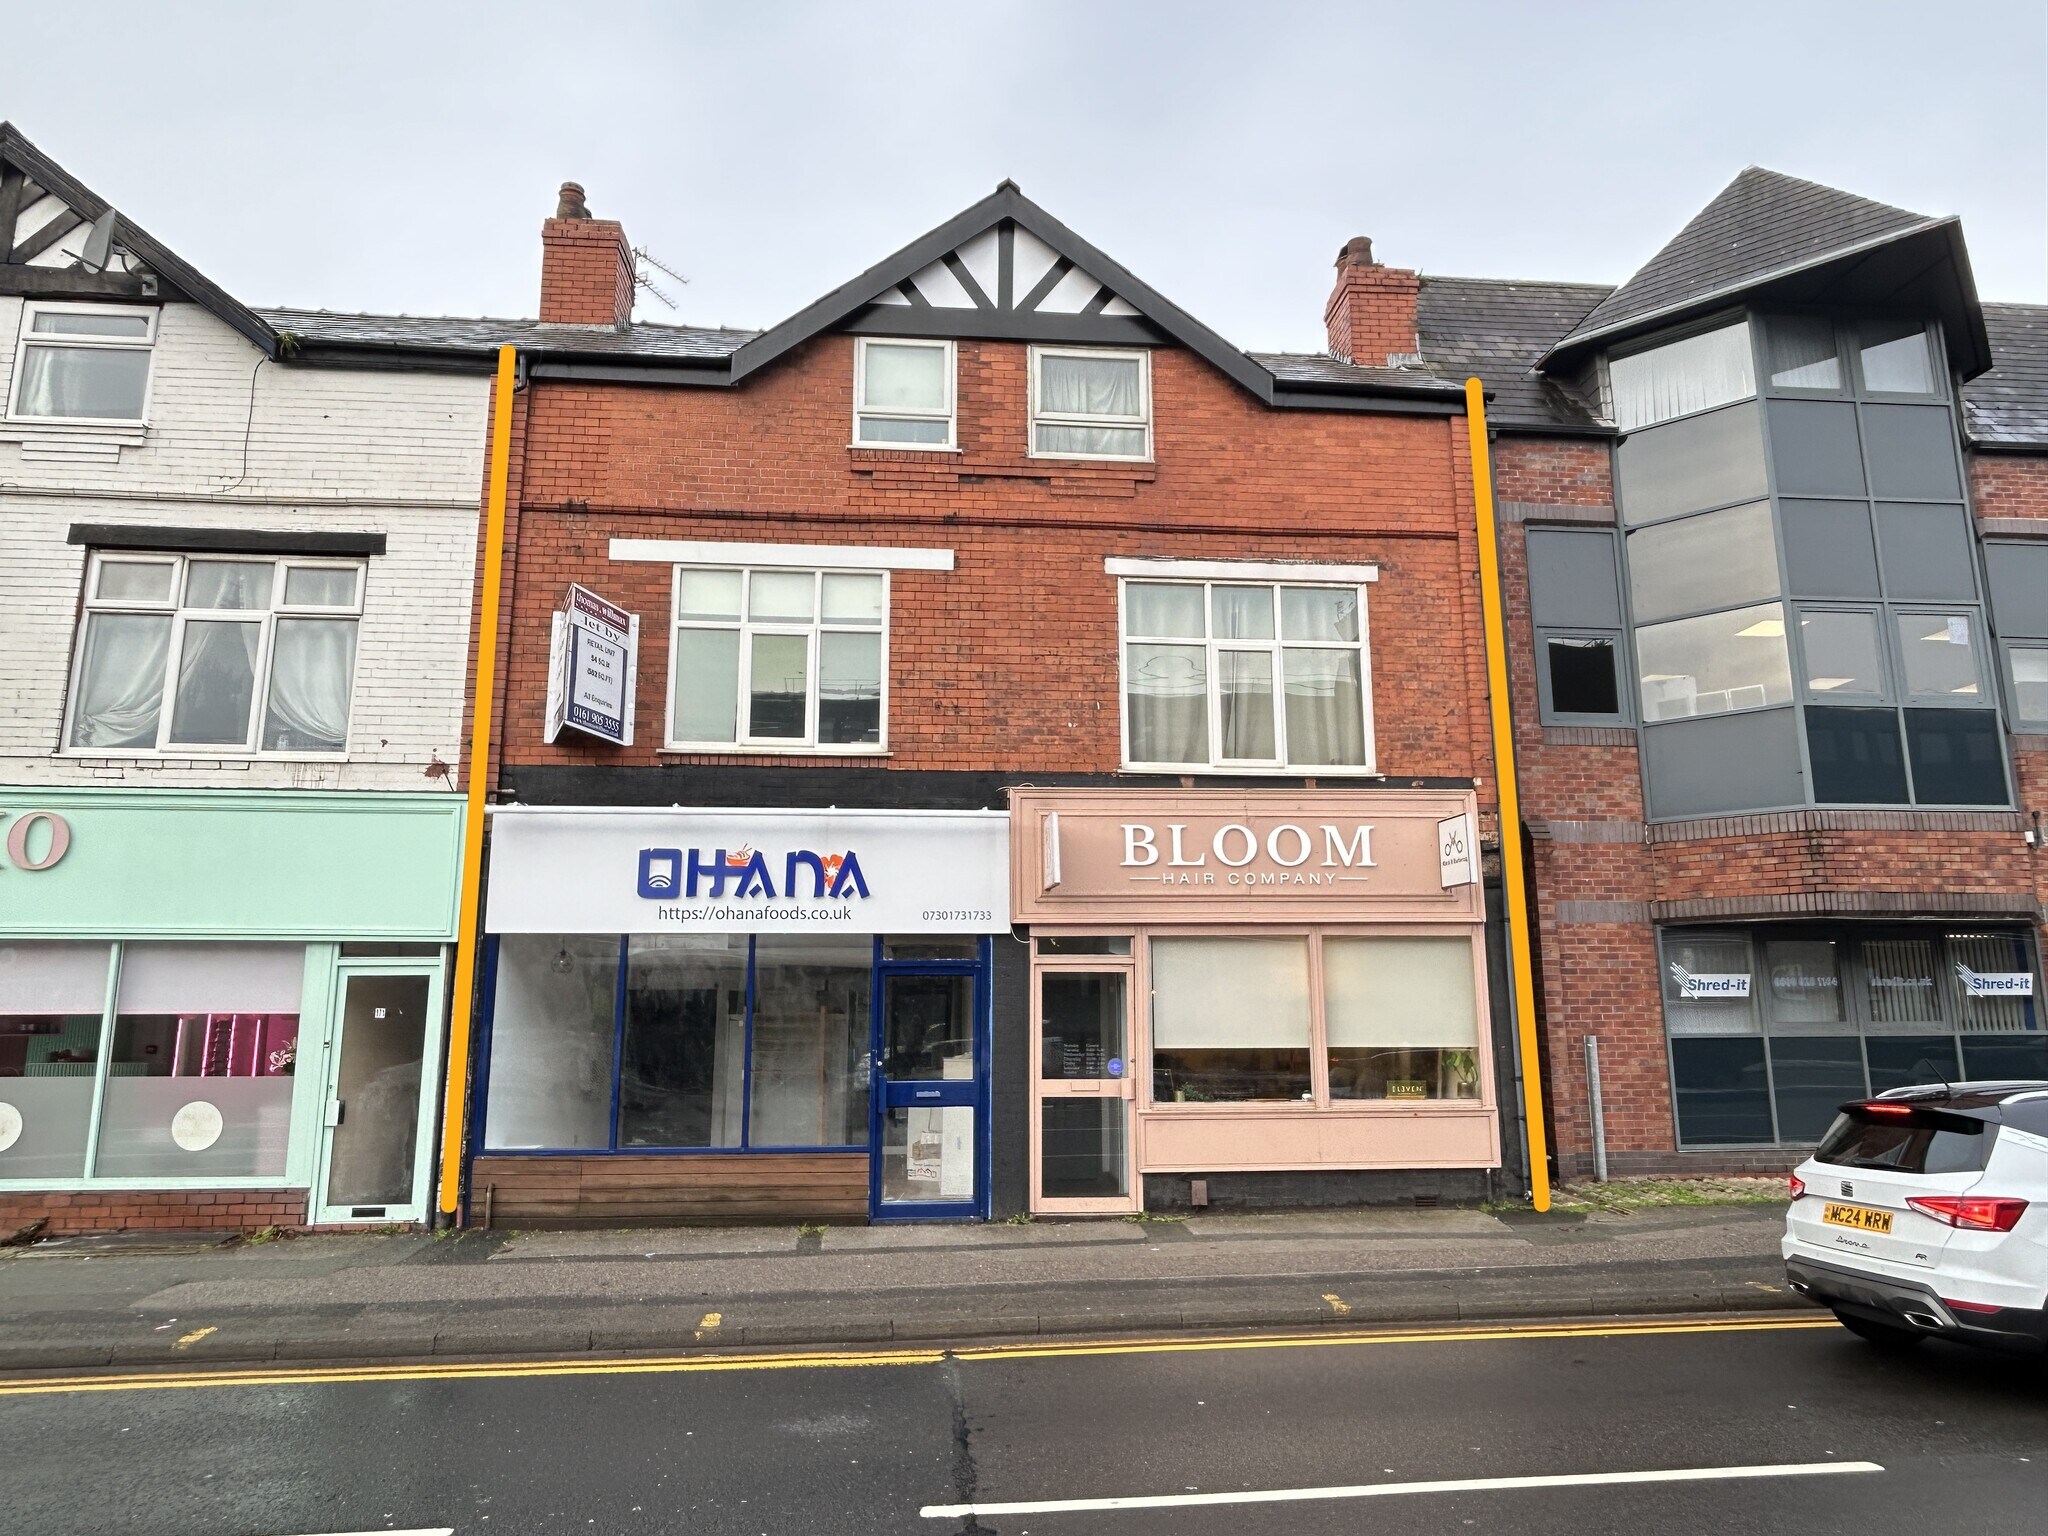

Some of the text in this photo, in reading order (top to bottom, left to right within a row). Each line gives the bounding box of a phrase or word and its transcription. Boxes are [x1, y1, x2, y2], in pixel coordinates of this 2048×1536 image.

[584, 616, 620, 642] let by
[587, 639, 616, 657] RETAIL UNIT
[592, 694, 613, 709] Enquiries
[574, 706, 590, 721] 0161
[591, 713, 604, 726] 905
[604, 718, 620, 732] 3555
[0, 811, 71, 871] O
[1120, 824, 1378, 867] BLOOM
[1163, 873, 1341, 885] HAIR COMPANY
[658, 905, 852, 923] https://ohanafoods.co.uk
[922, 910, 992, 921] 07301731733
[1688, 979, 1747, 991] Shred-it
[1973, 977, 2030, 989] Shred-it
